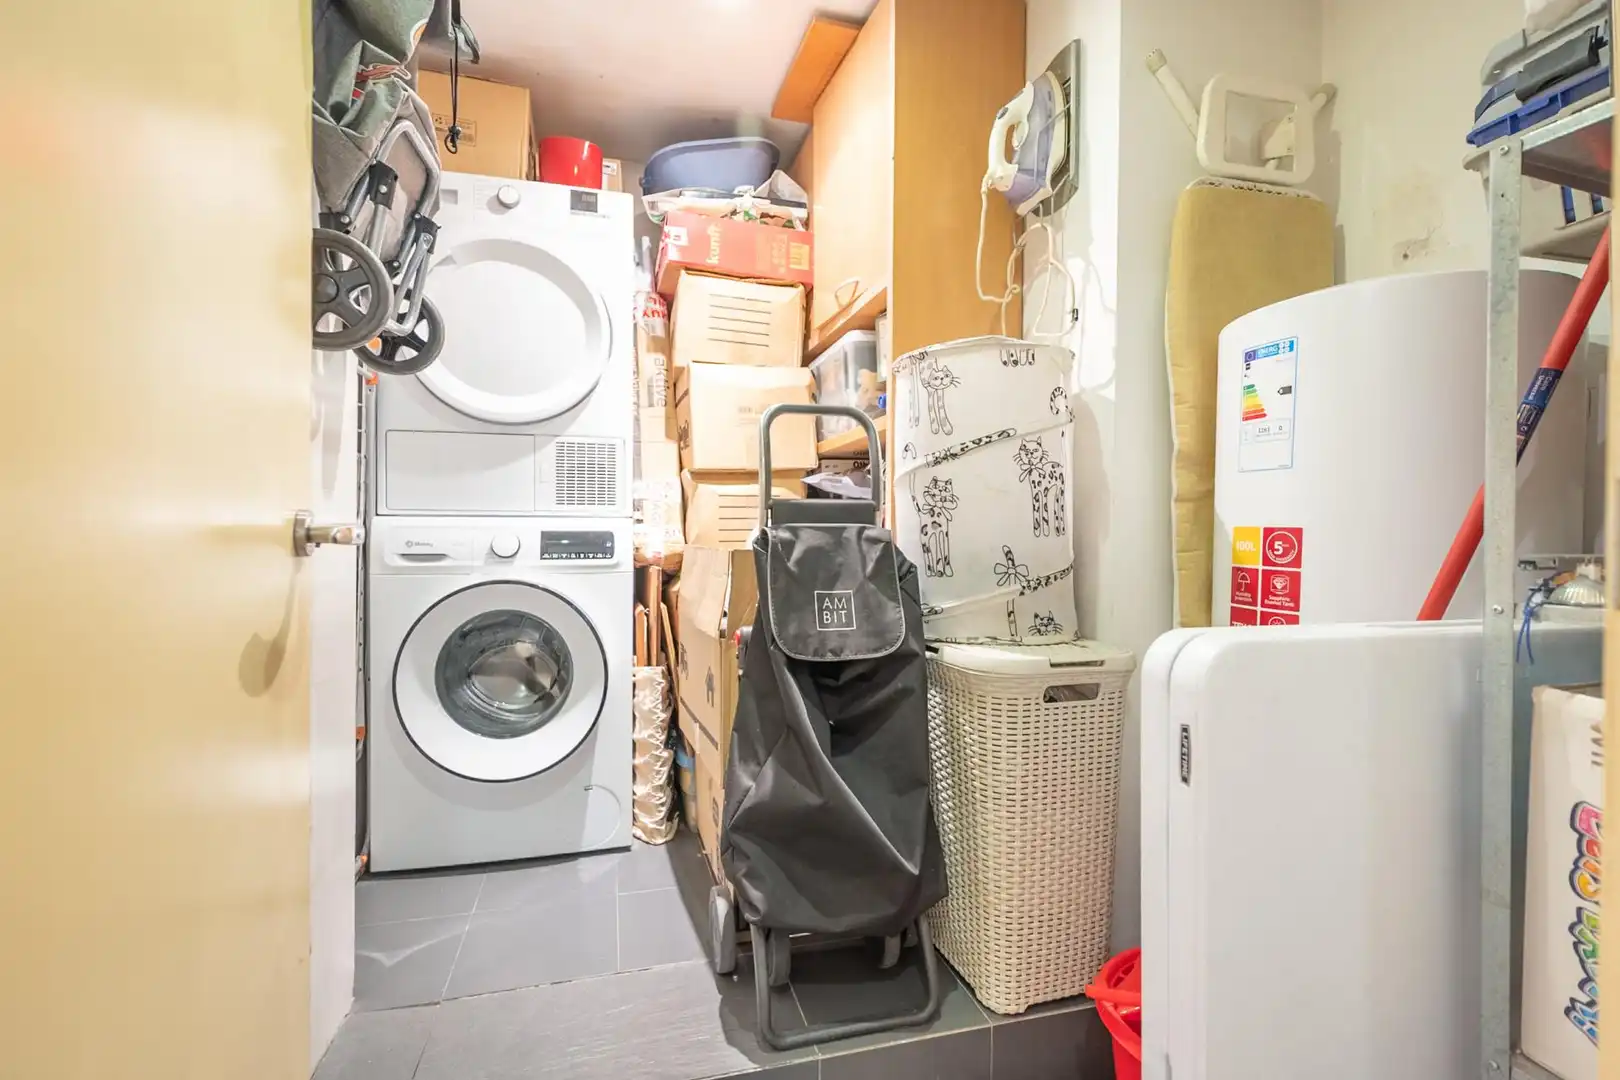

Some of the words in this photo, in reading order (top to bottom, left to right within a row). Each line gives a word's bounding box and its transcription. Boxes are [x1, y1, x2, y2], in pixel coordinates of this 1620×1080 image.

[654, 357, 670, 408] aktive
[1273, 541, 1283, 555] 5
[822, 597, 847, 609] AM
[823, 610, 847, 624] BIT
